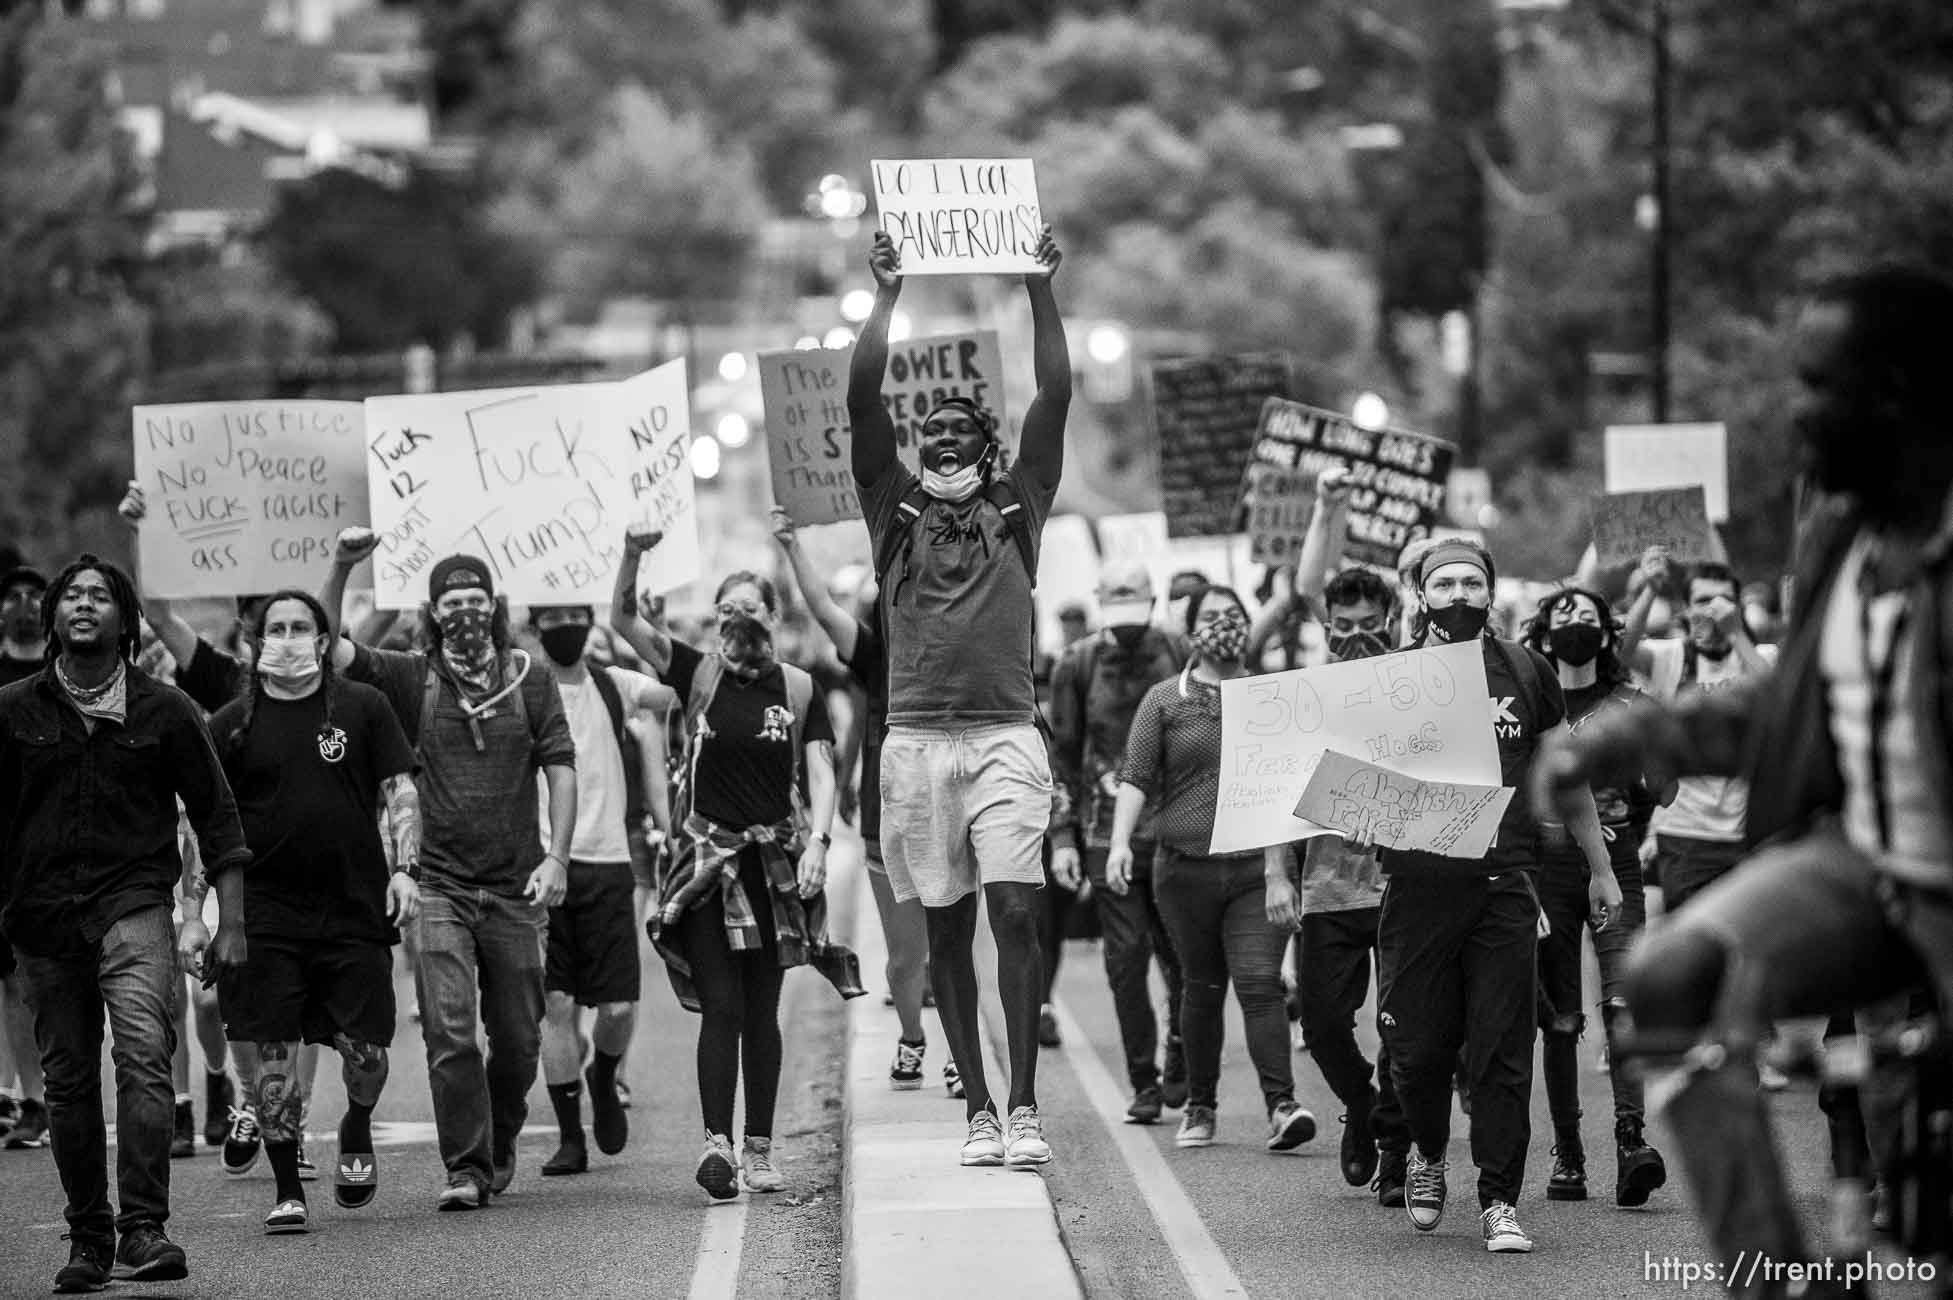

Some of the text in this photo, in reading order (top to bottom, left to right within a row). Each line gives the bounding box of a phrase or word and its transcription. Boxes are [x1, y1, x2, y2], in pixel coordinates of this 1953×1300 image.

[877, 164, 911, 195] DO
[959, 165, 1022, 195] LOOK
[890, 340, 982, 383] OWER
[145, 408, 353, 468] No Justice
[629, 405, 668, 451] NO
[157, 448, 329, 494] No Peace
[389, 469, 429, 499] 12
[165, 492, 348, 529] FUCK racist
[191, 543, 240, 571] ass
[1497, 725, 1521, 739] YM
